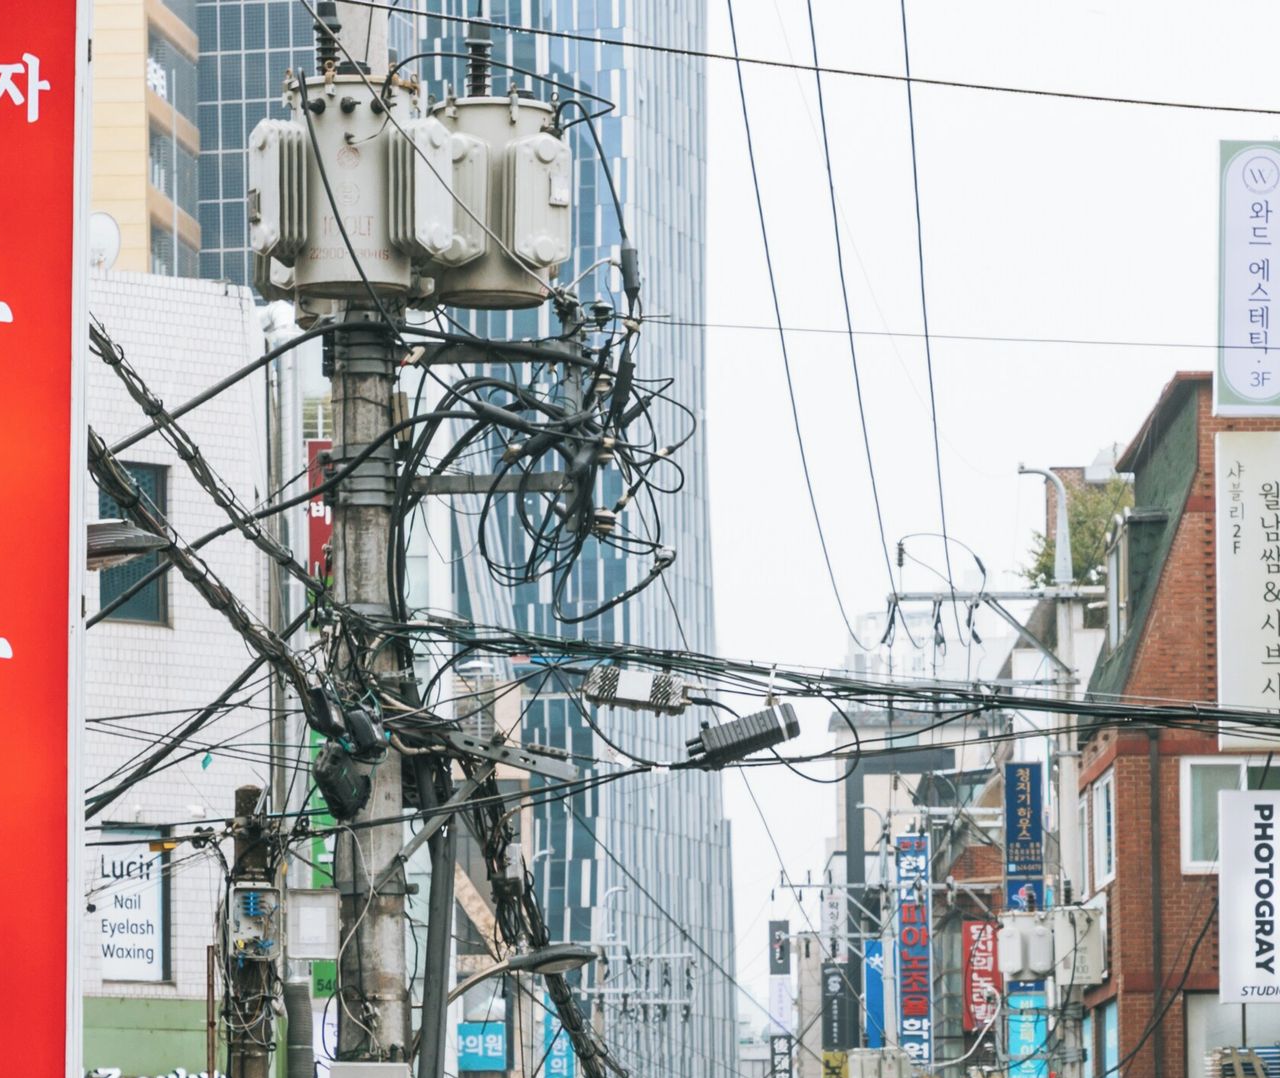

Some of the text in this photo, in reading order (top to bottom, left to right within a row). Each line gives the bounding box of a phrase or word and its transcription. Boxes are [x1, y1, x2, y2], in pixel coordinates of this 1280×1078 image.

[1247, 199, 1273, 355] 와드 에스테틱
[1250, 371, 1271, 387] 3F
[1226, 460, 1245, 520] 샤블리
[1232, 524, 1242, 554] 2F
[114, 894, 141, 910] Nail
[1254, 803, 1275, 975] PHOTOGRAY
[101, 918, 154, 941] Eyelash
[101, 943, 154, 963] Waxing
